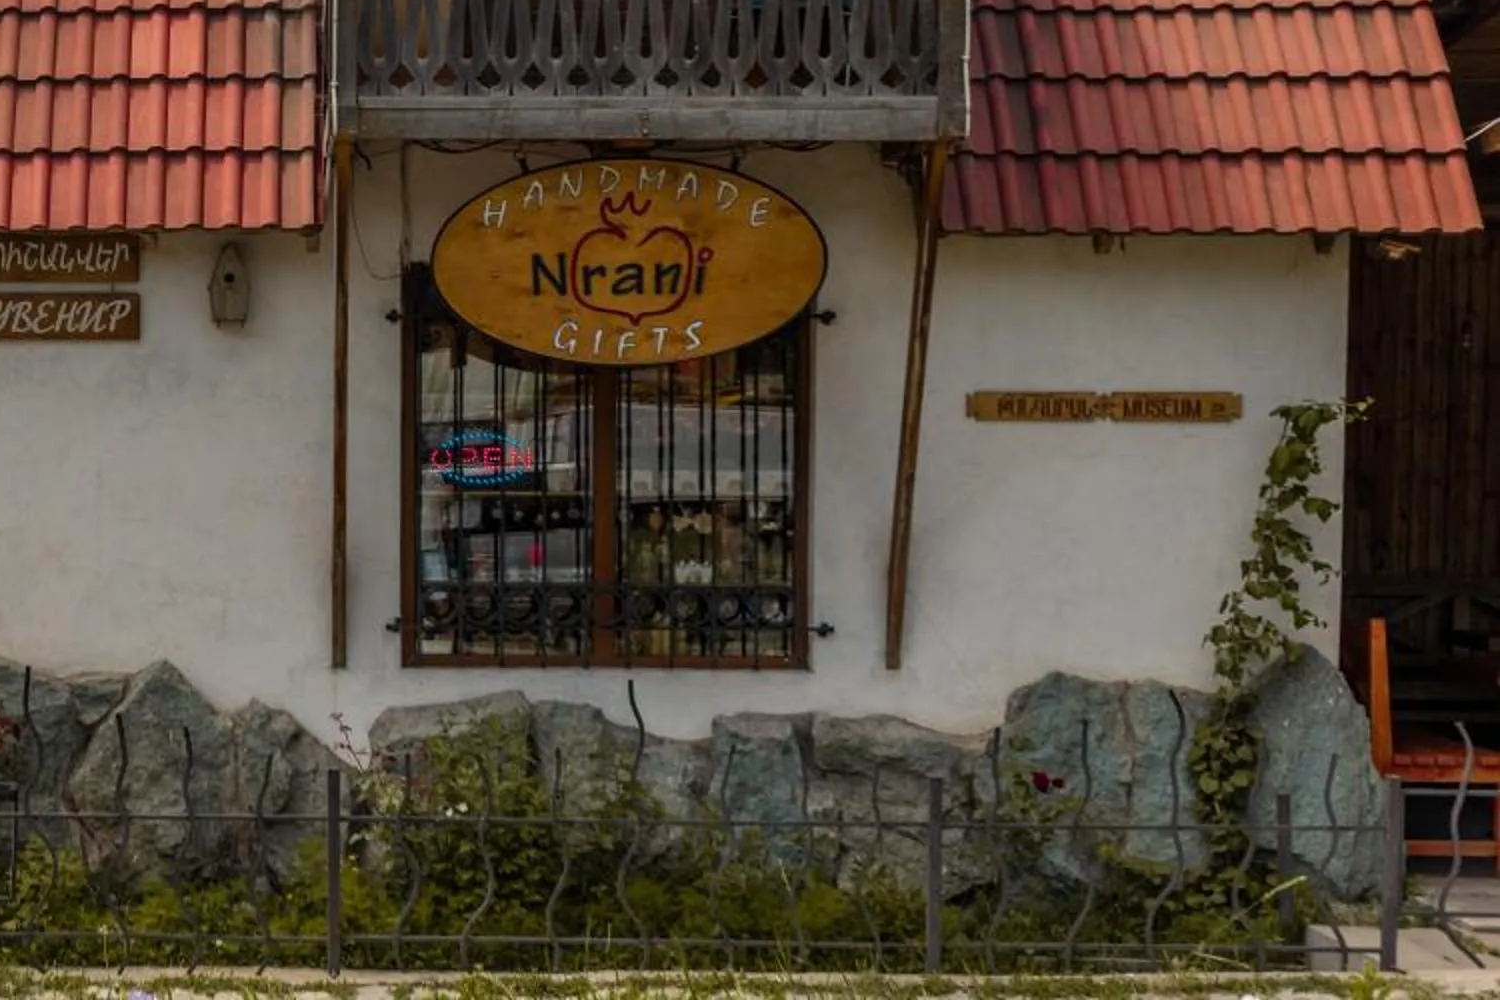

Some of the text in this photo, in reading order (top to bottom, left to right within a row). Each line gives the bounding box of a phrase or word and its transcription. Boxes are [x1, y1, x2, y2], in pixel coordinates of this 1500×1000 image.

[482, 166, 774, 229] HANDMADE
[531, 247, 714, 297] Nrani
[553, 321, 705, 359] GIFTS
[1123, 398, 1202, 418] MUSEUM
[428, 446, 533, 471] OPEN
